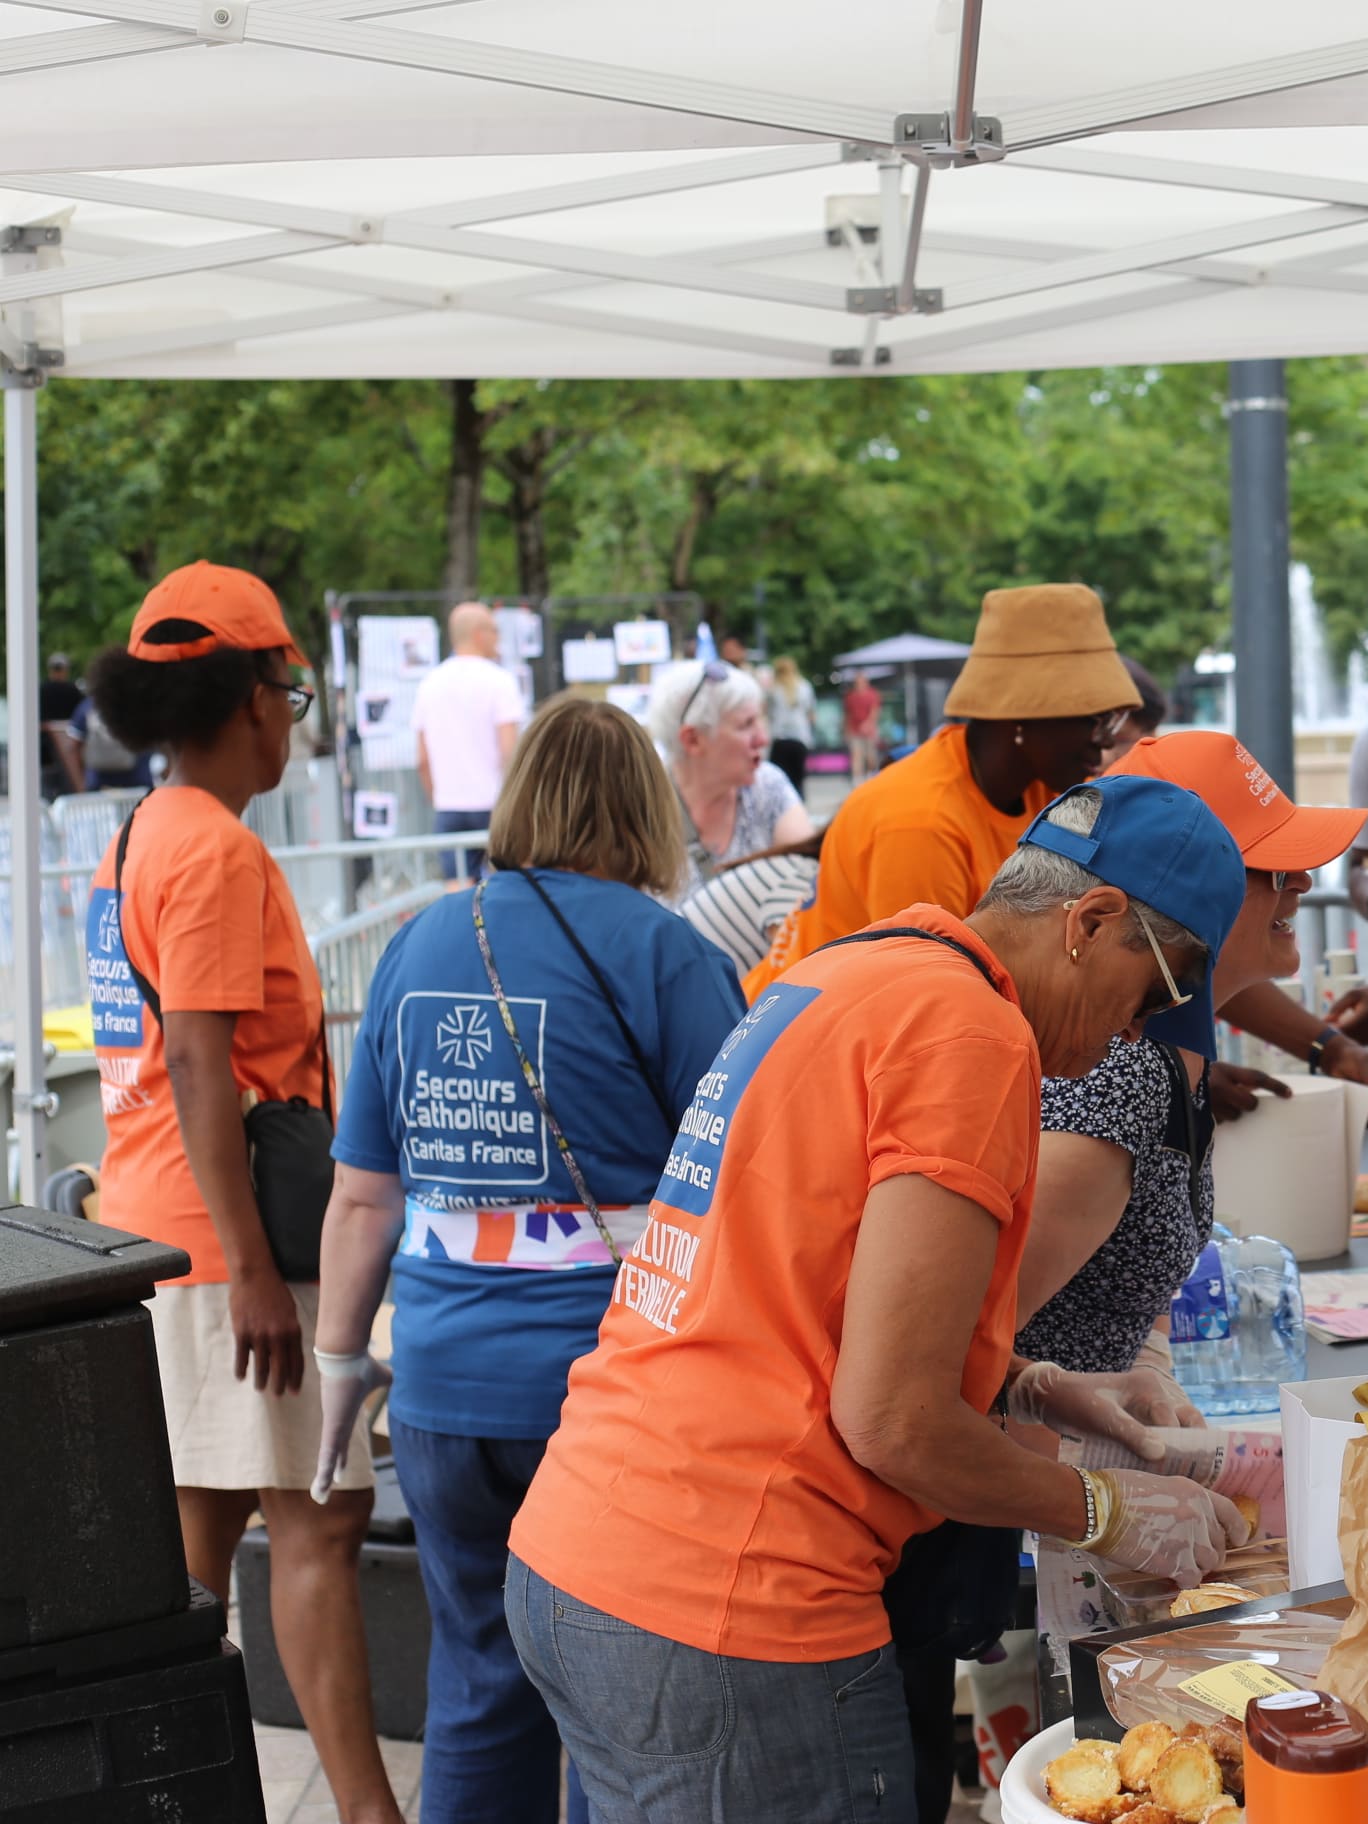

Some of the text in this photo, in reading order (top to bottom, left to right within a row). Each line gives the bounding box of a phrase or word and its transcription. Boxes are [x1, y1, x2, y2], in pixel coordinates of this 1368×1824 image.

[88, 953, 131, 981] ecours
[415, 1069, 517, 1104] Secours
[409, 1137, 538, 1166] Caritas France
